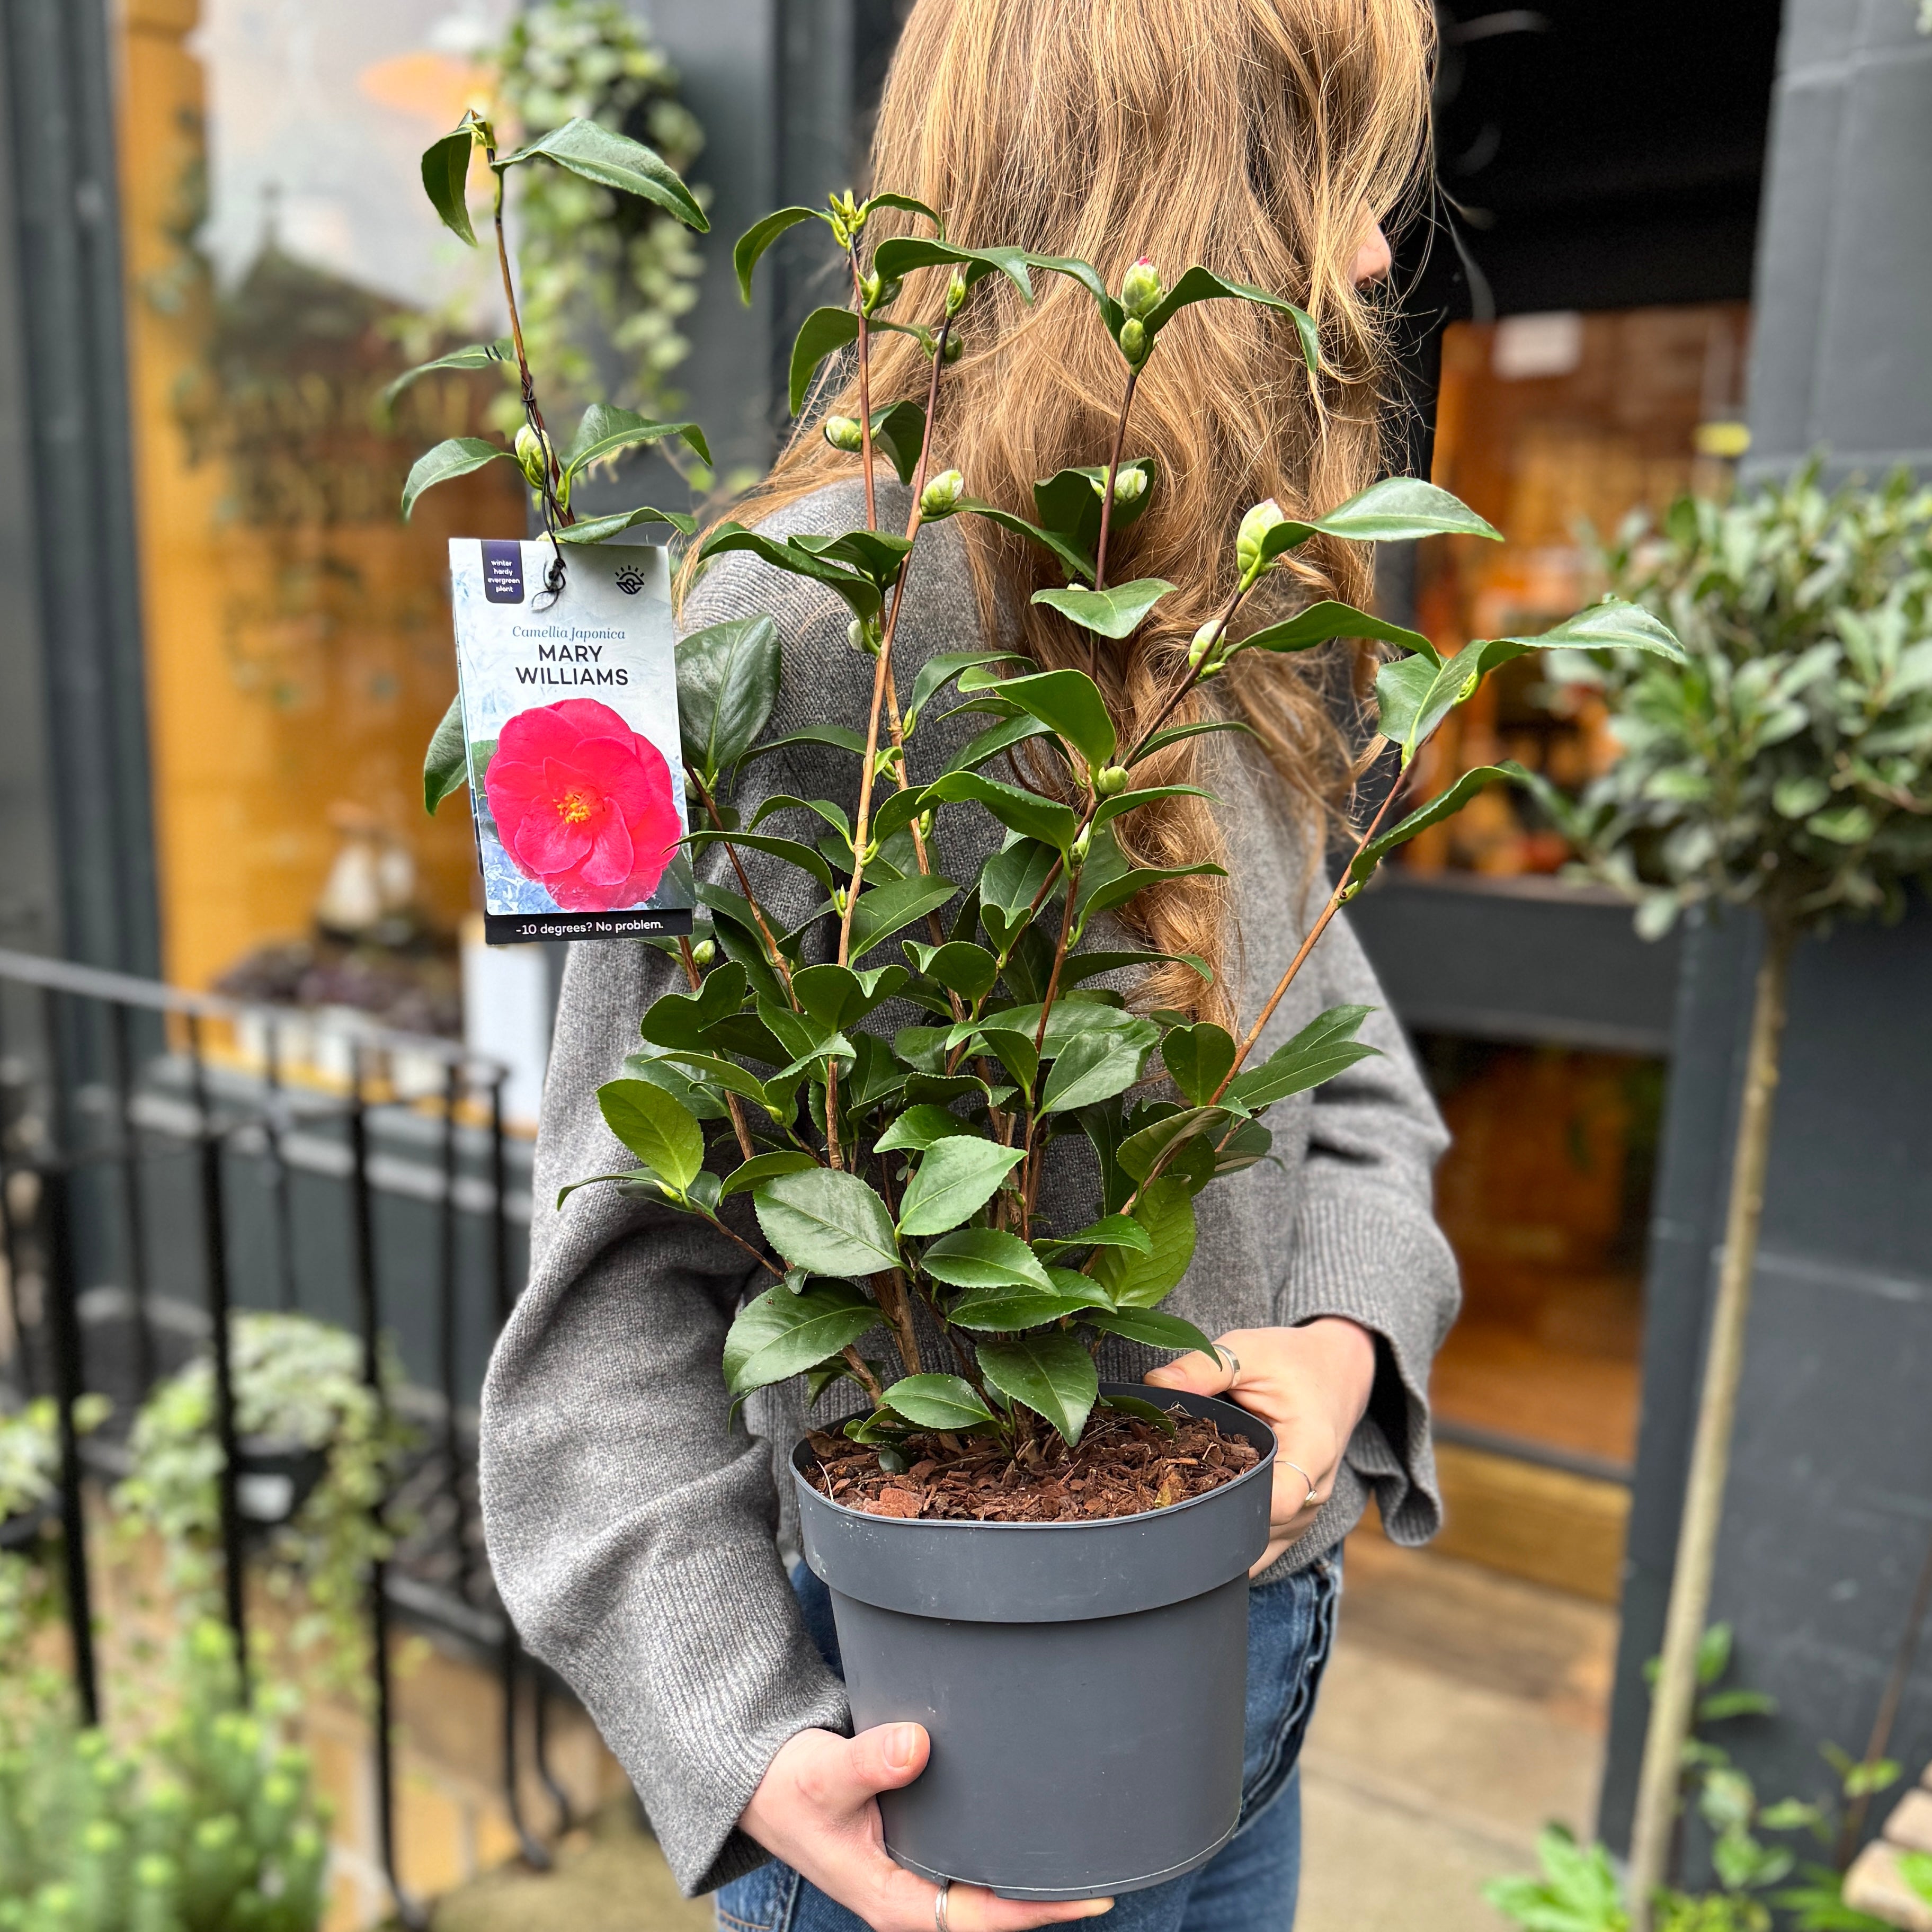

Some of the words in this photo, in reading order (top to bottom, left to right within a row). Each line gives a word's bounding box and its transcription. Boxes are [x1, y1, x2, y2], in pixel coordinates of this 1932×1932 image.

[493, 567, 513, 576] hardy
[512, 626, 567, 639] Camellia
[569, 627, 626, 643] Japonica
[538, 644, 602, 662] MARY
[515, 667, 628, 685] WILLIAMS
[516, 924, 536, 935] -10
[540, 921, 592, 936] degrees?
[596, 921, 611, 931] No
[615, 920, 663, 933] problem.
